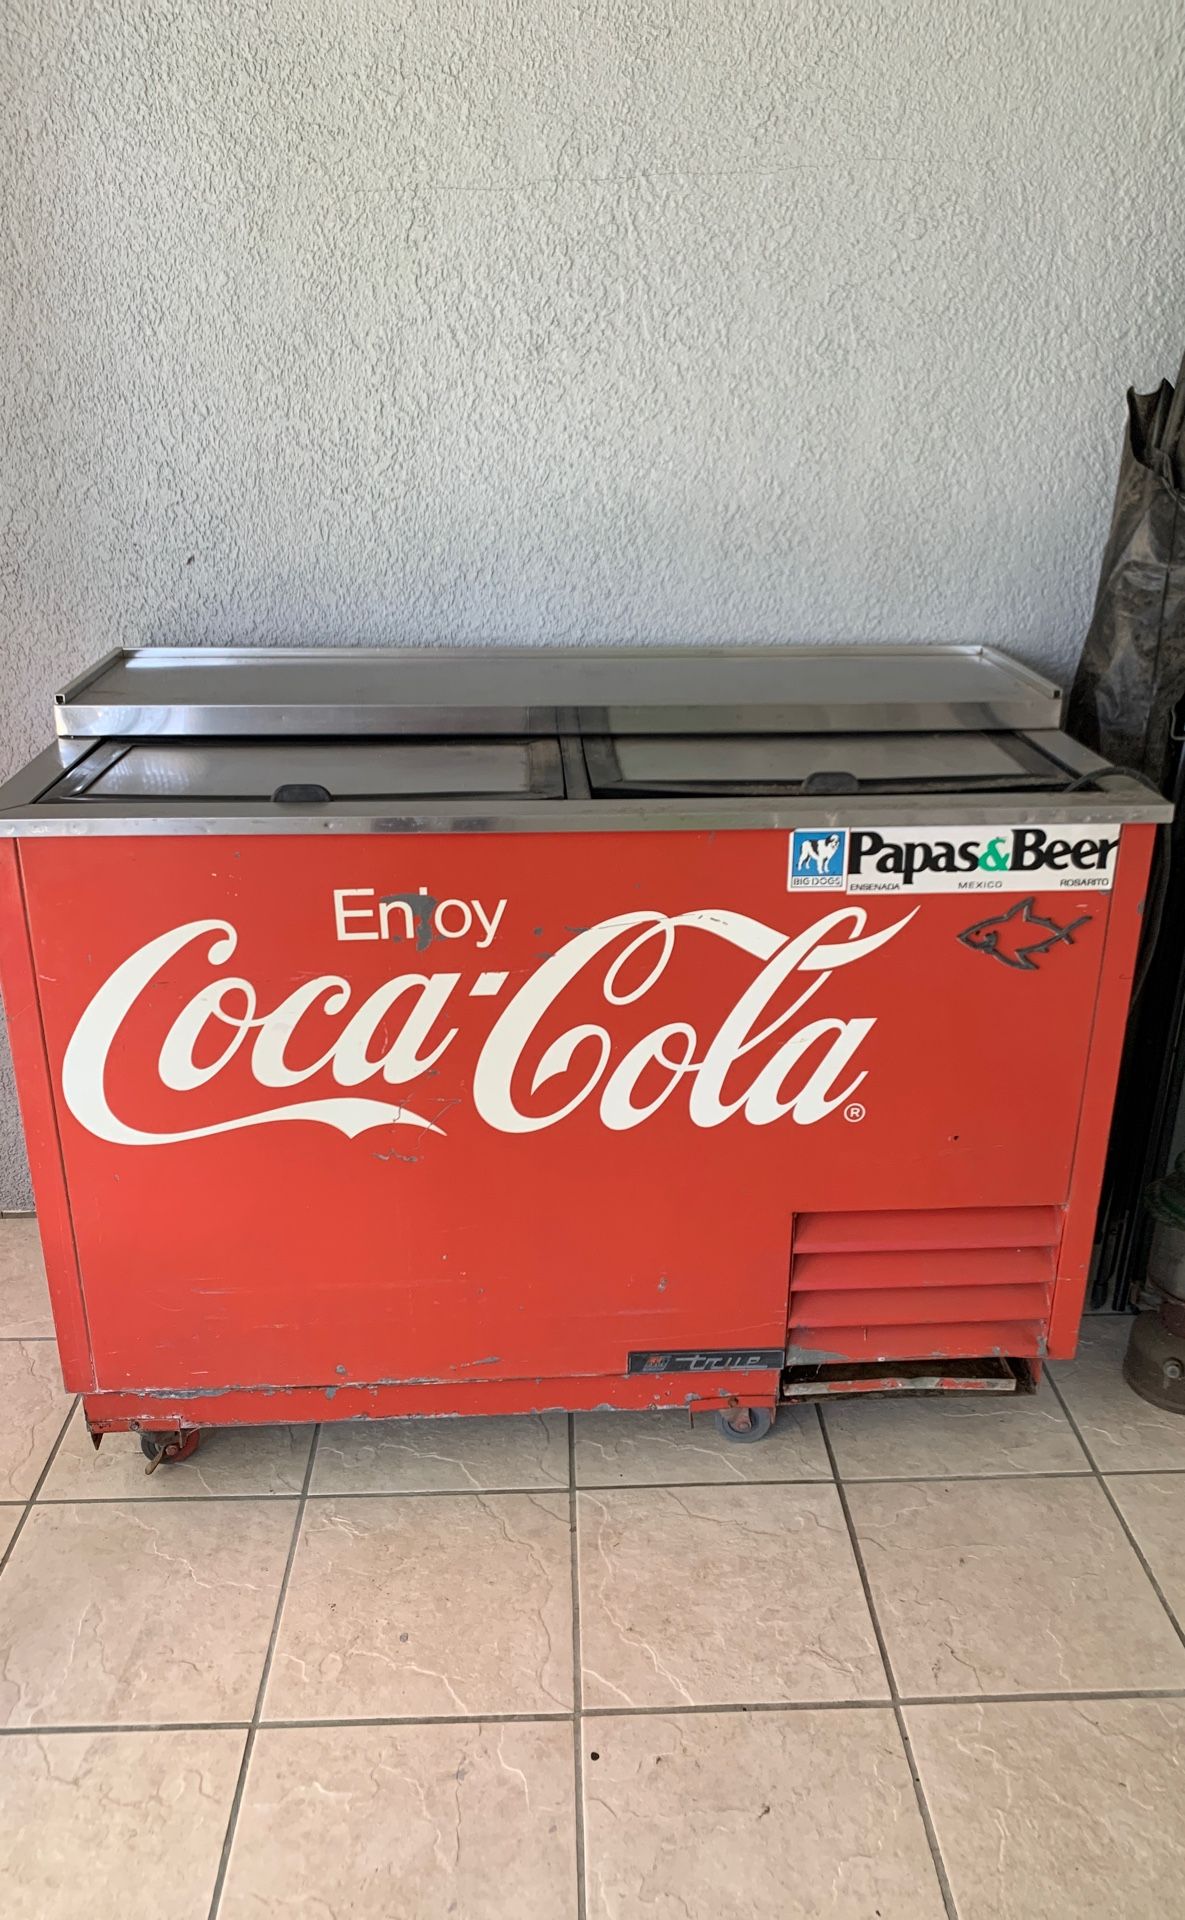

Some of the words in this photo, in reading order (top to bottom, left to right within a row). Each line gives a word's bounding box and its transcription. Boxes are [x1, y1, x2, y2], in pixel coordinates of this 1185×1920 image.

[793, 877, 810, 886] BIG
[811, 877, 841, 886] DOGS
[850, 883, 900, 891] ENSENADA
[957, 880, 1003, 889] MEXICO
[1060, 878, 1110, 887] ROSARITO
[333, 886, 508, 949] Enoy
[62, 904, 921, 1146] Coca-Cola
